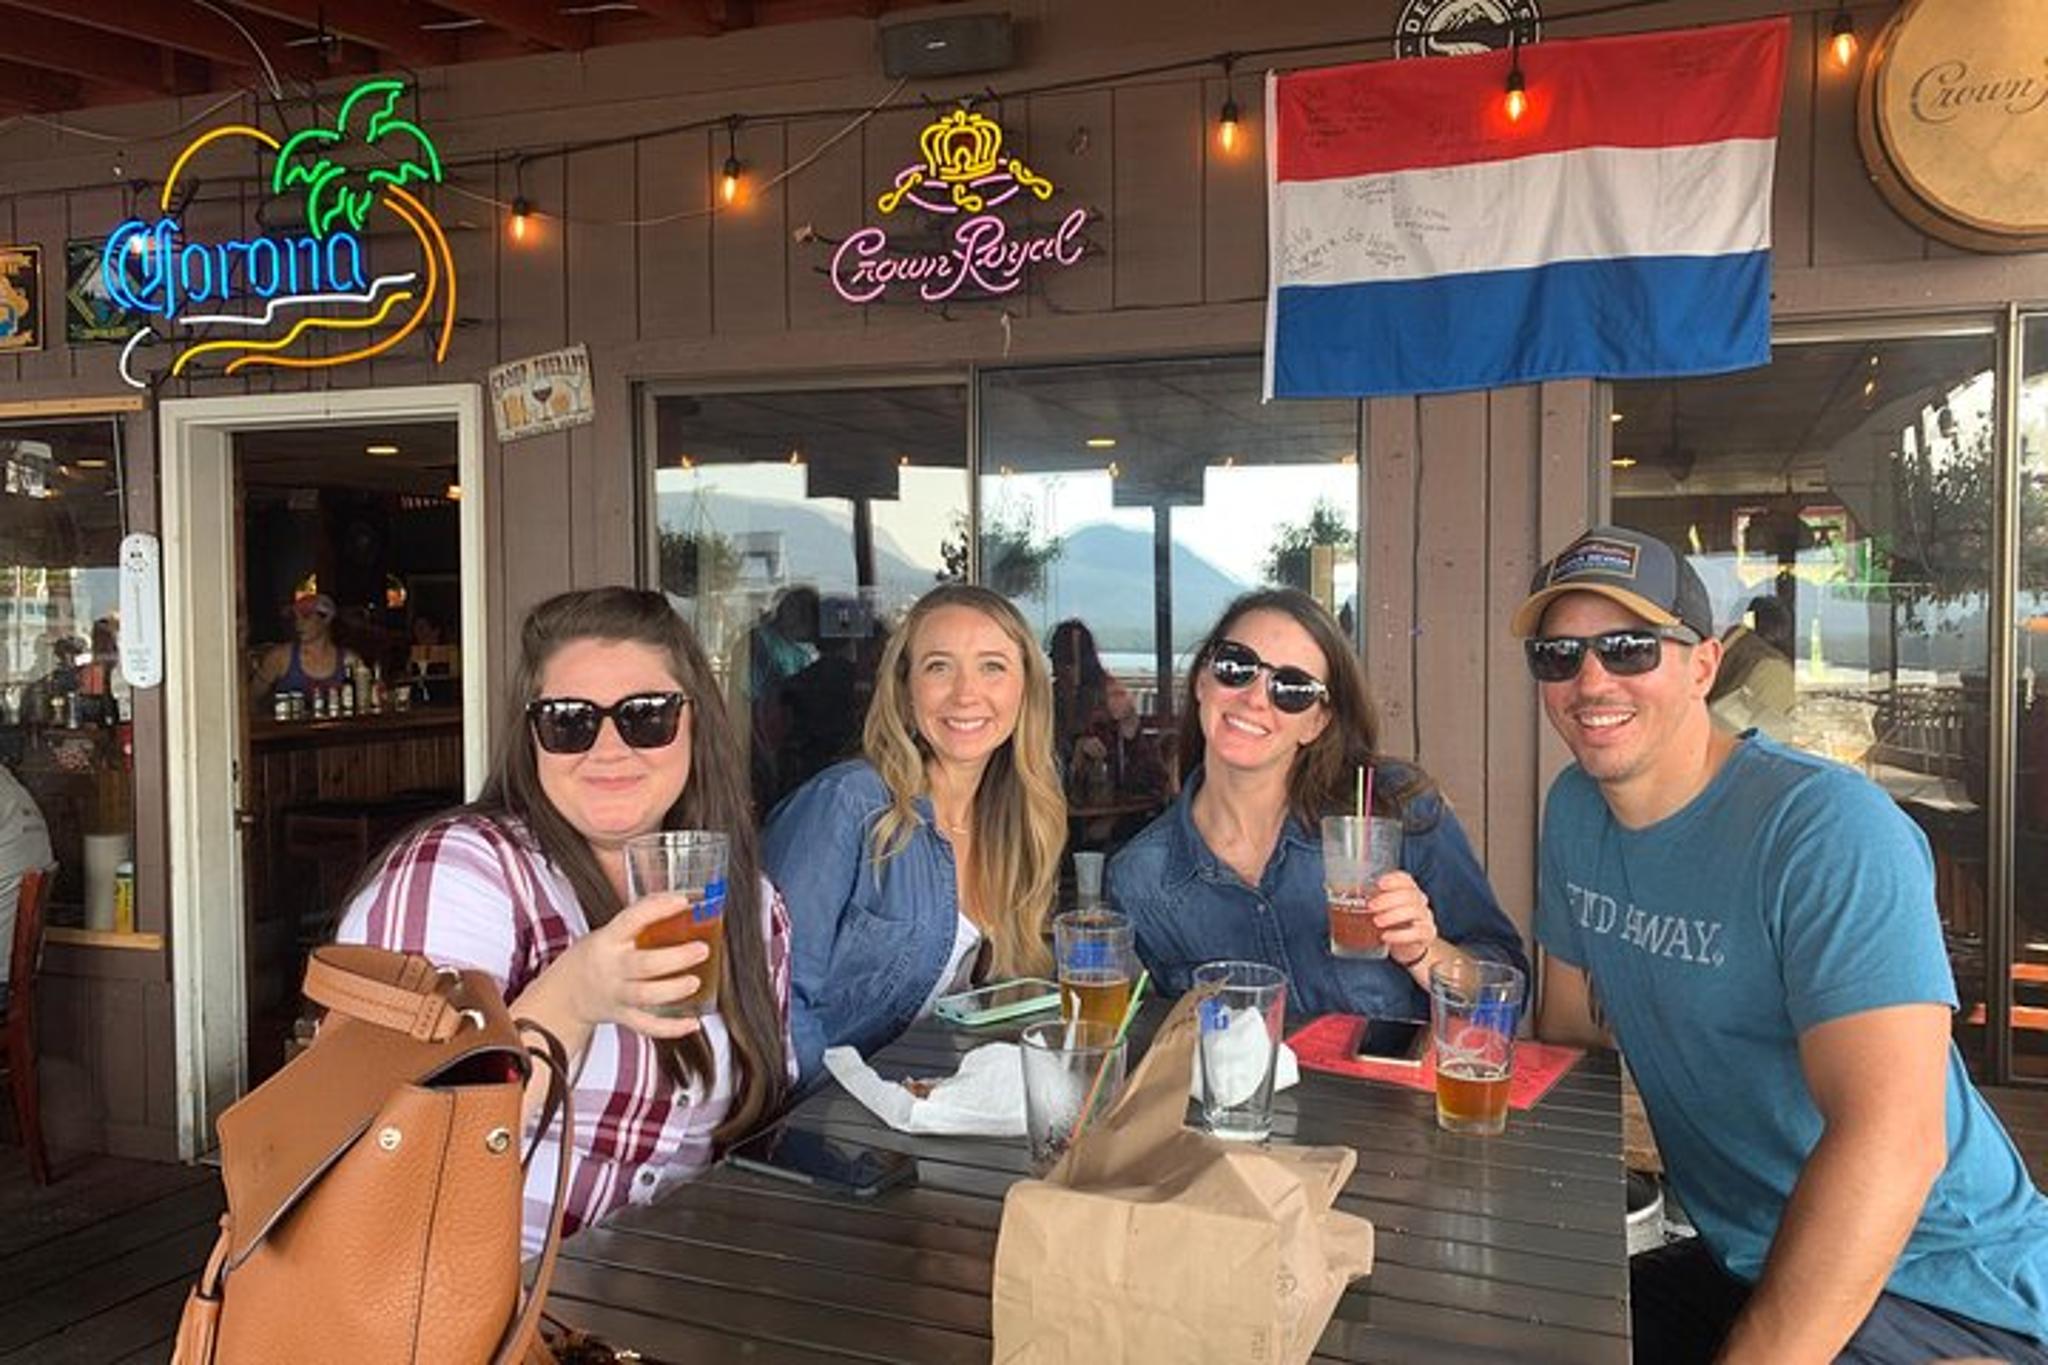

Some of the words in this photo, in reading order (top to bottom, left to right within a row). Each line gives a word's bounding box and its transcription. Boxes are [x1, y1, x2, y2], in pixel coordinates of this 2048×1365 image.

[1910, 59, 2034, 124] Crown
[101, 217, 366, 319] Corona
[831, 227, 953, 302] Crown
[921, 209, 1086, 300] Royal
